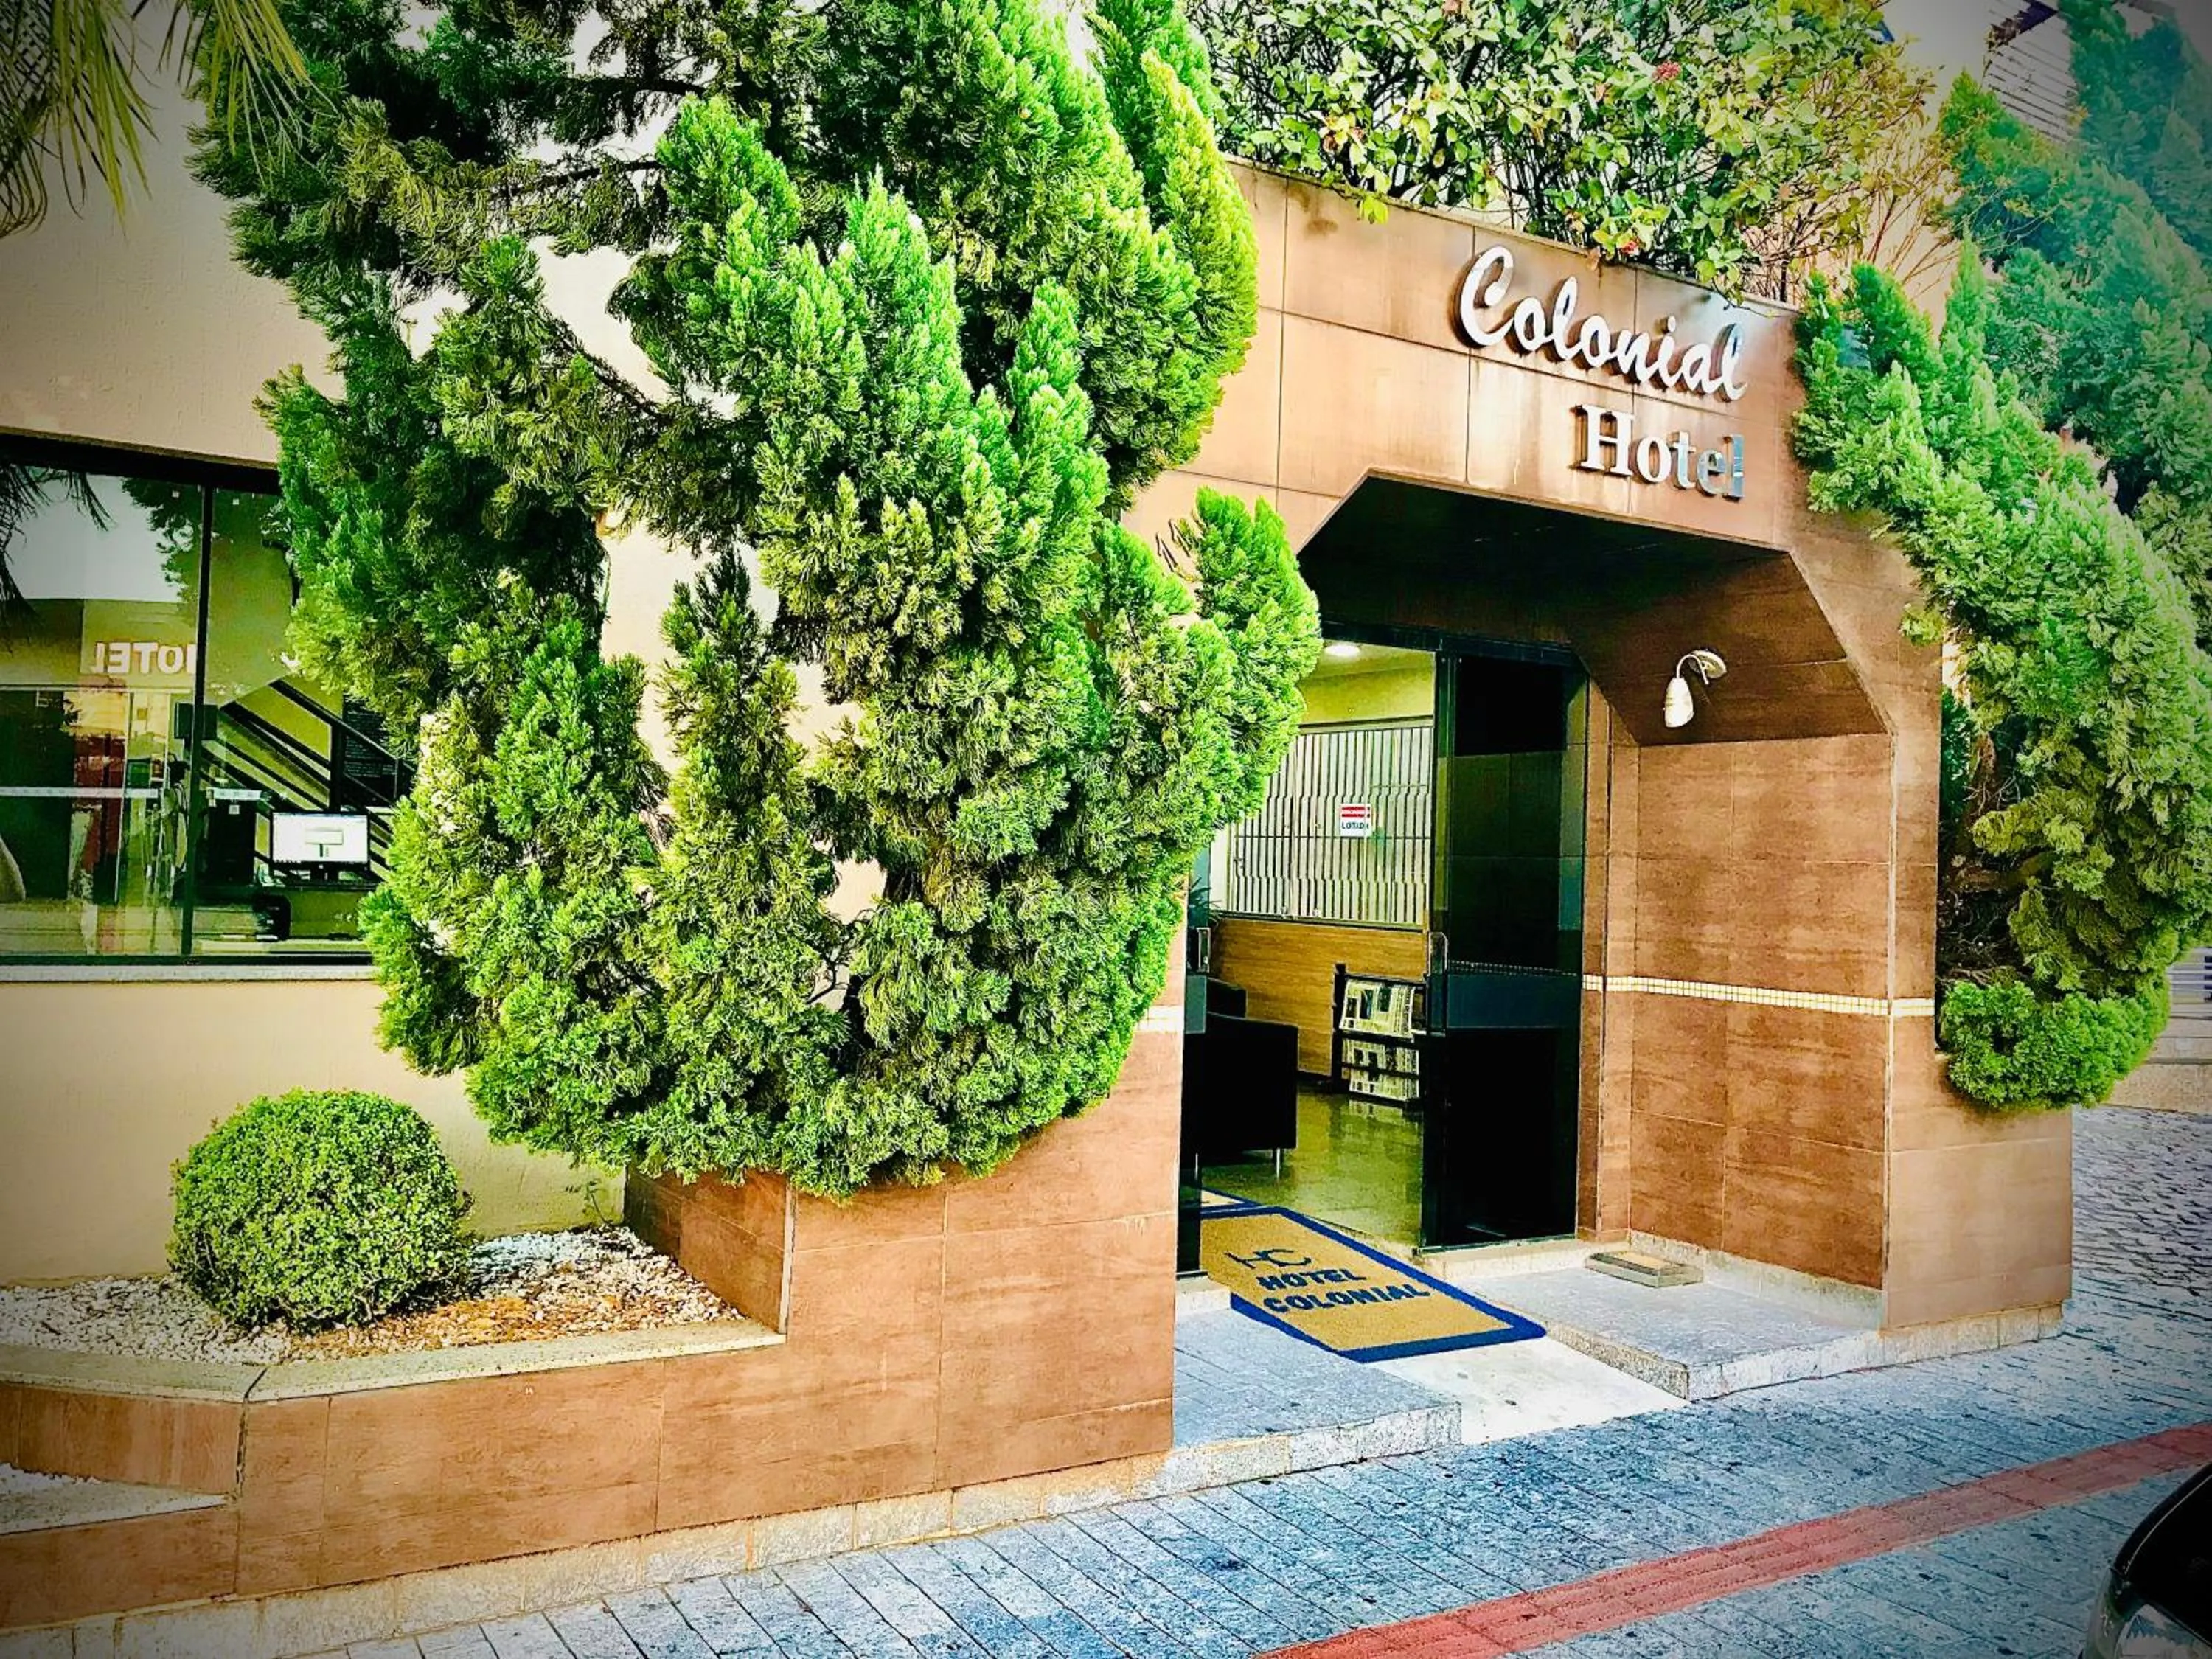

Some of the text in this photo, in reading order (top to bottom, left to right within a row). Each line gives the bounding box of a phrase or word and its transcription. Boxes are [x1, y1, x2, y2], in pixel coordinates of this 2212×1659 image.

[1460, 245, 1747, 401] Colonial
[1573, 403, 1745, 498] Hotel
[1256, 1268, 1367, 1291] HOTEL
[1263, 1283, 1431, 1313] COLONIAL
